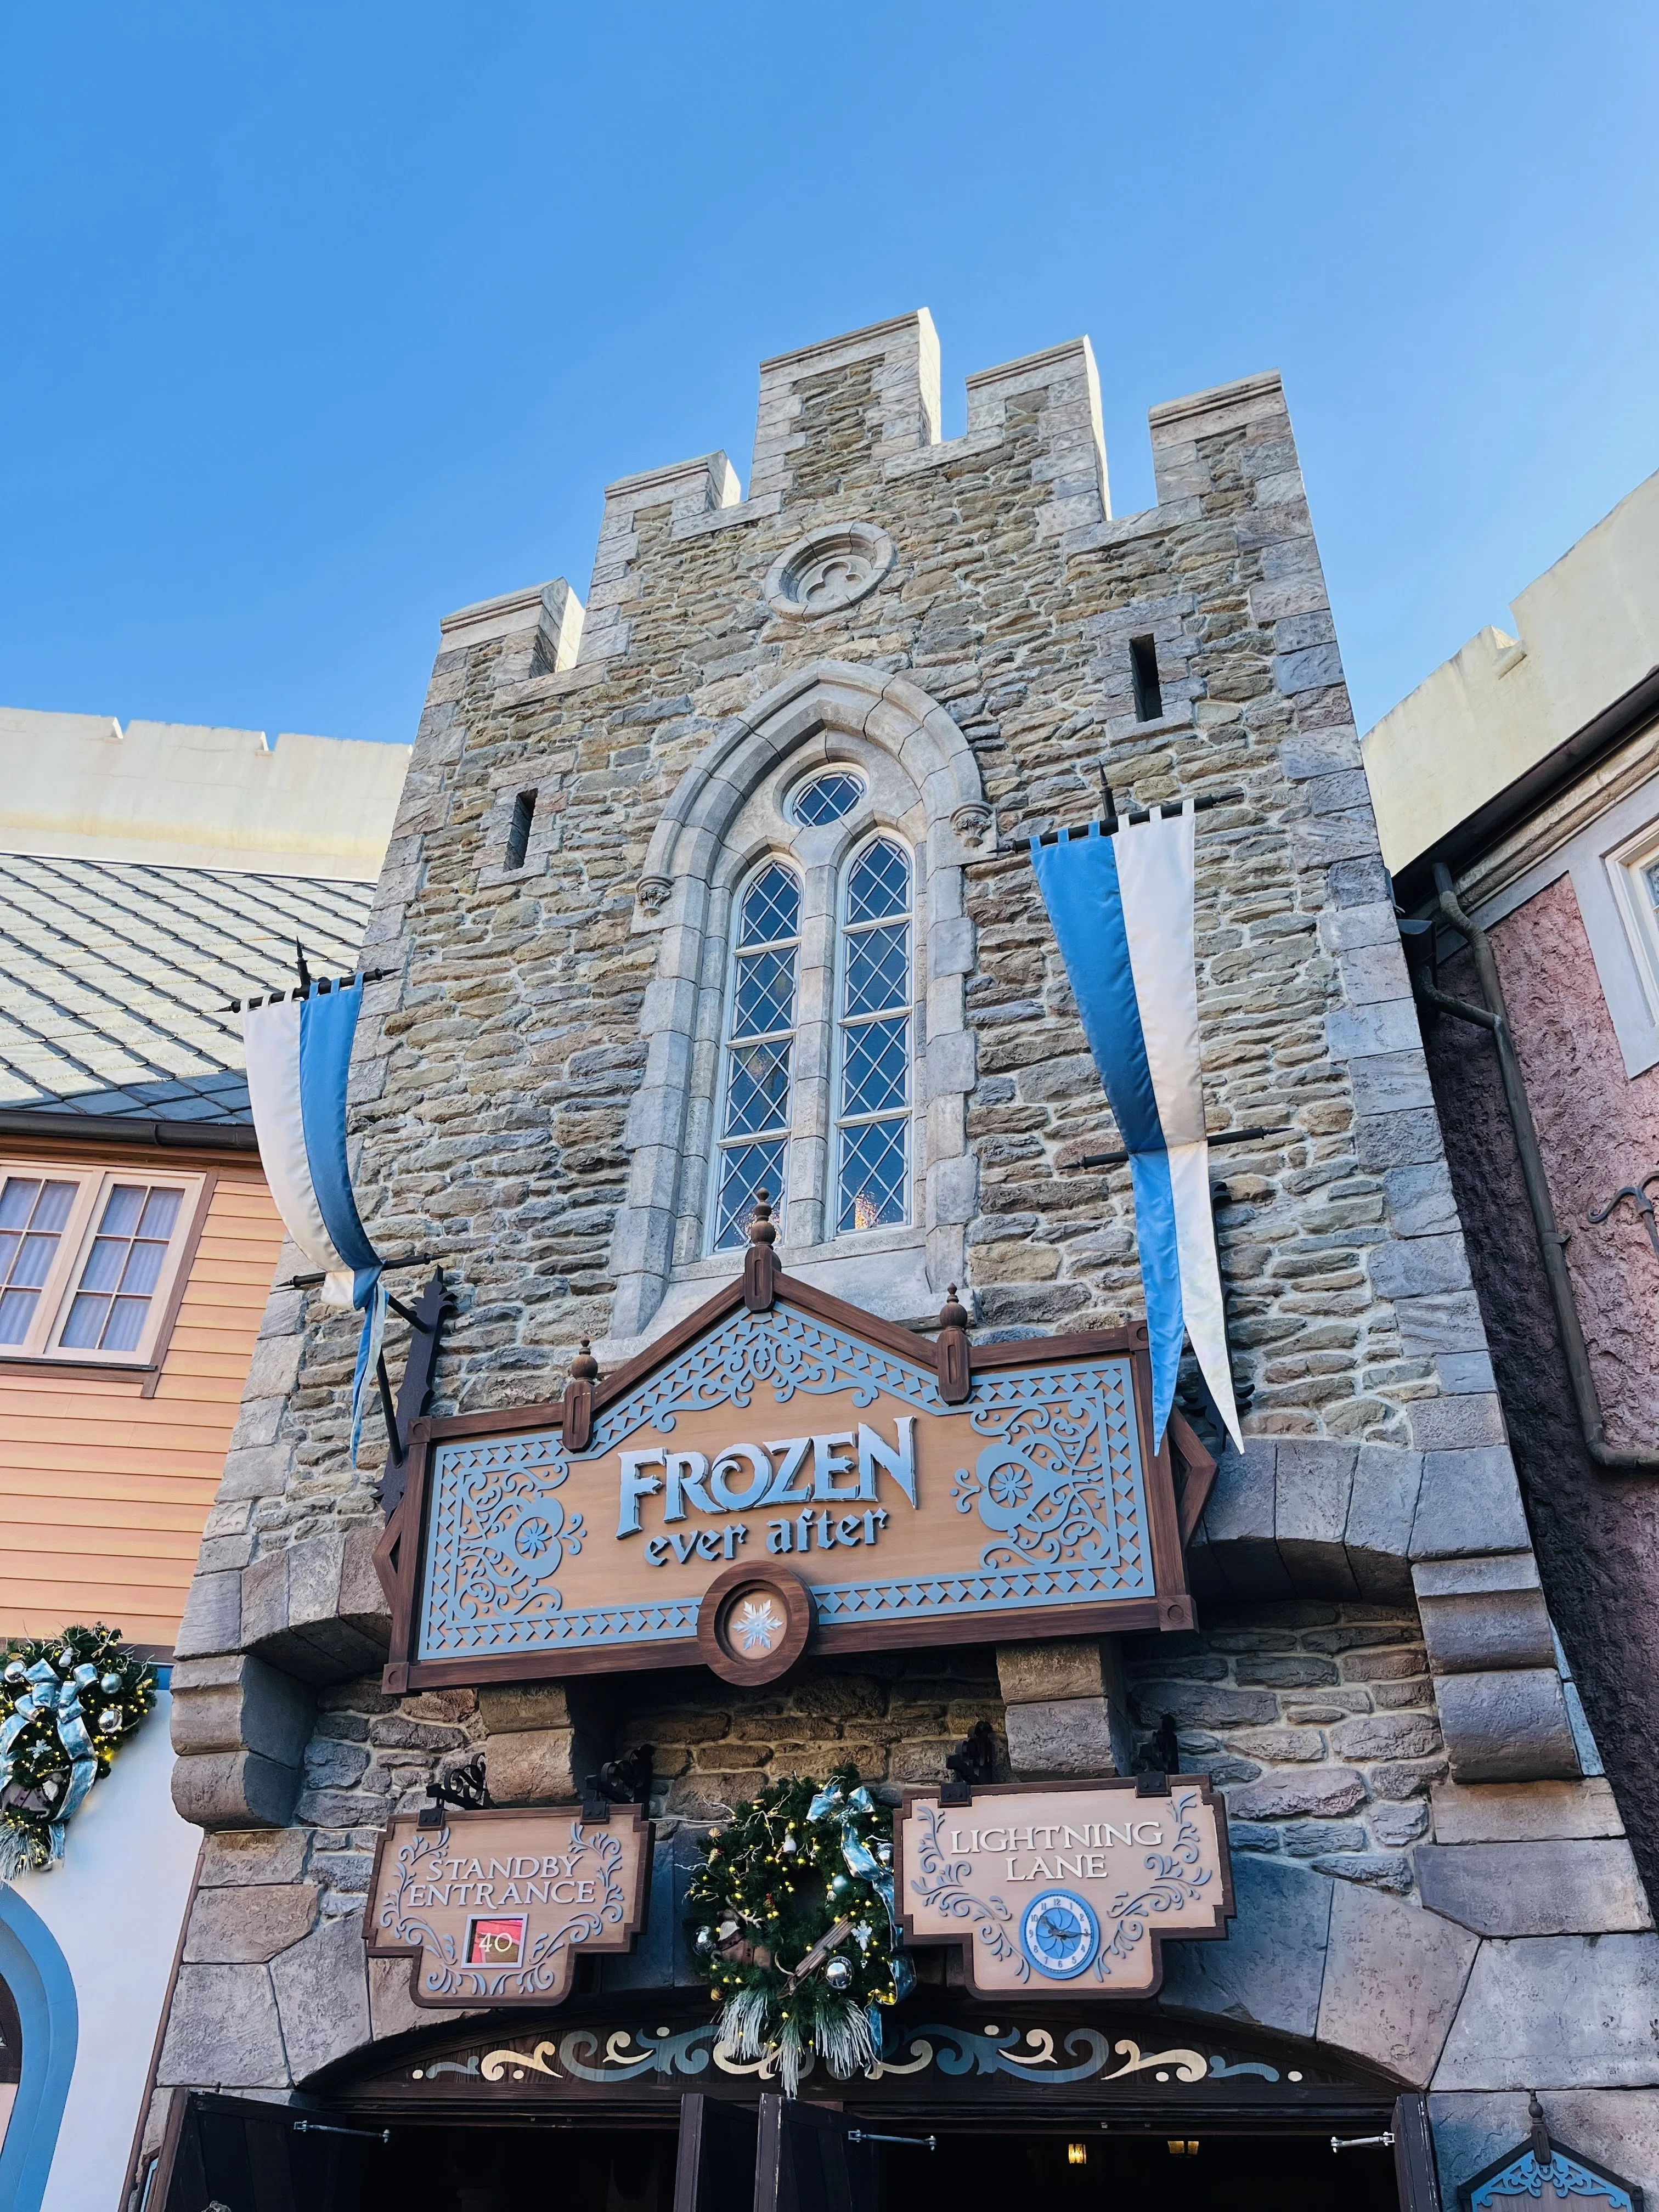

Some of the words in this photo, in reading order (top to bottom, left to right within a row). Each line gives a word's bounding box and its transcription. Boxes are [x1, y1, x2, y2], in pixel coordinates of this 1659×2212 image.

[616, 1416, 918, 1539] FROZEN
[644, 1523, 748, 1566] ever
[766, 1507, 890, 1555] after
[950, 1821, 1163, 1854] LIGHTNING
[426, 1855, 583, 1882] STANDBY
[1006, 1854, 1108, 1882] LANE
[407, 1880, 595, 1909] ENTRANCE
[478, 1932, 513, 1953] 40
[1029, 1929, 1034, 1938] 9
[1072, 1956, 1077, 1964] 5
[1081, 1944, 1085, 1953] 4
